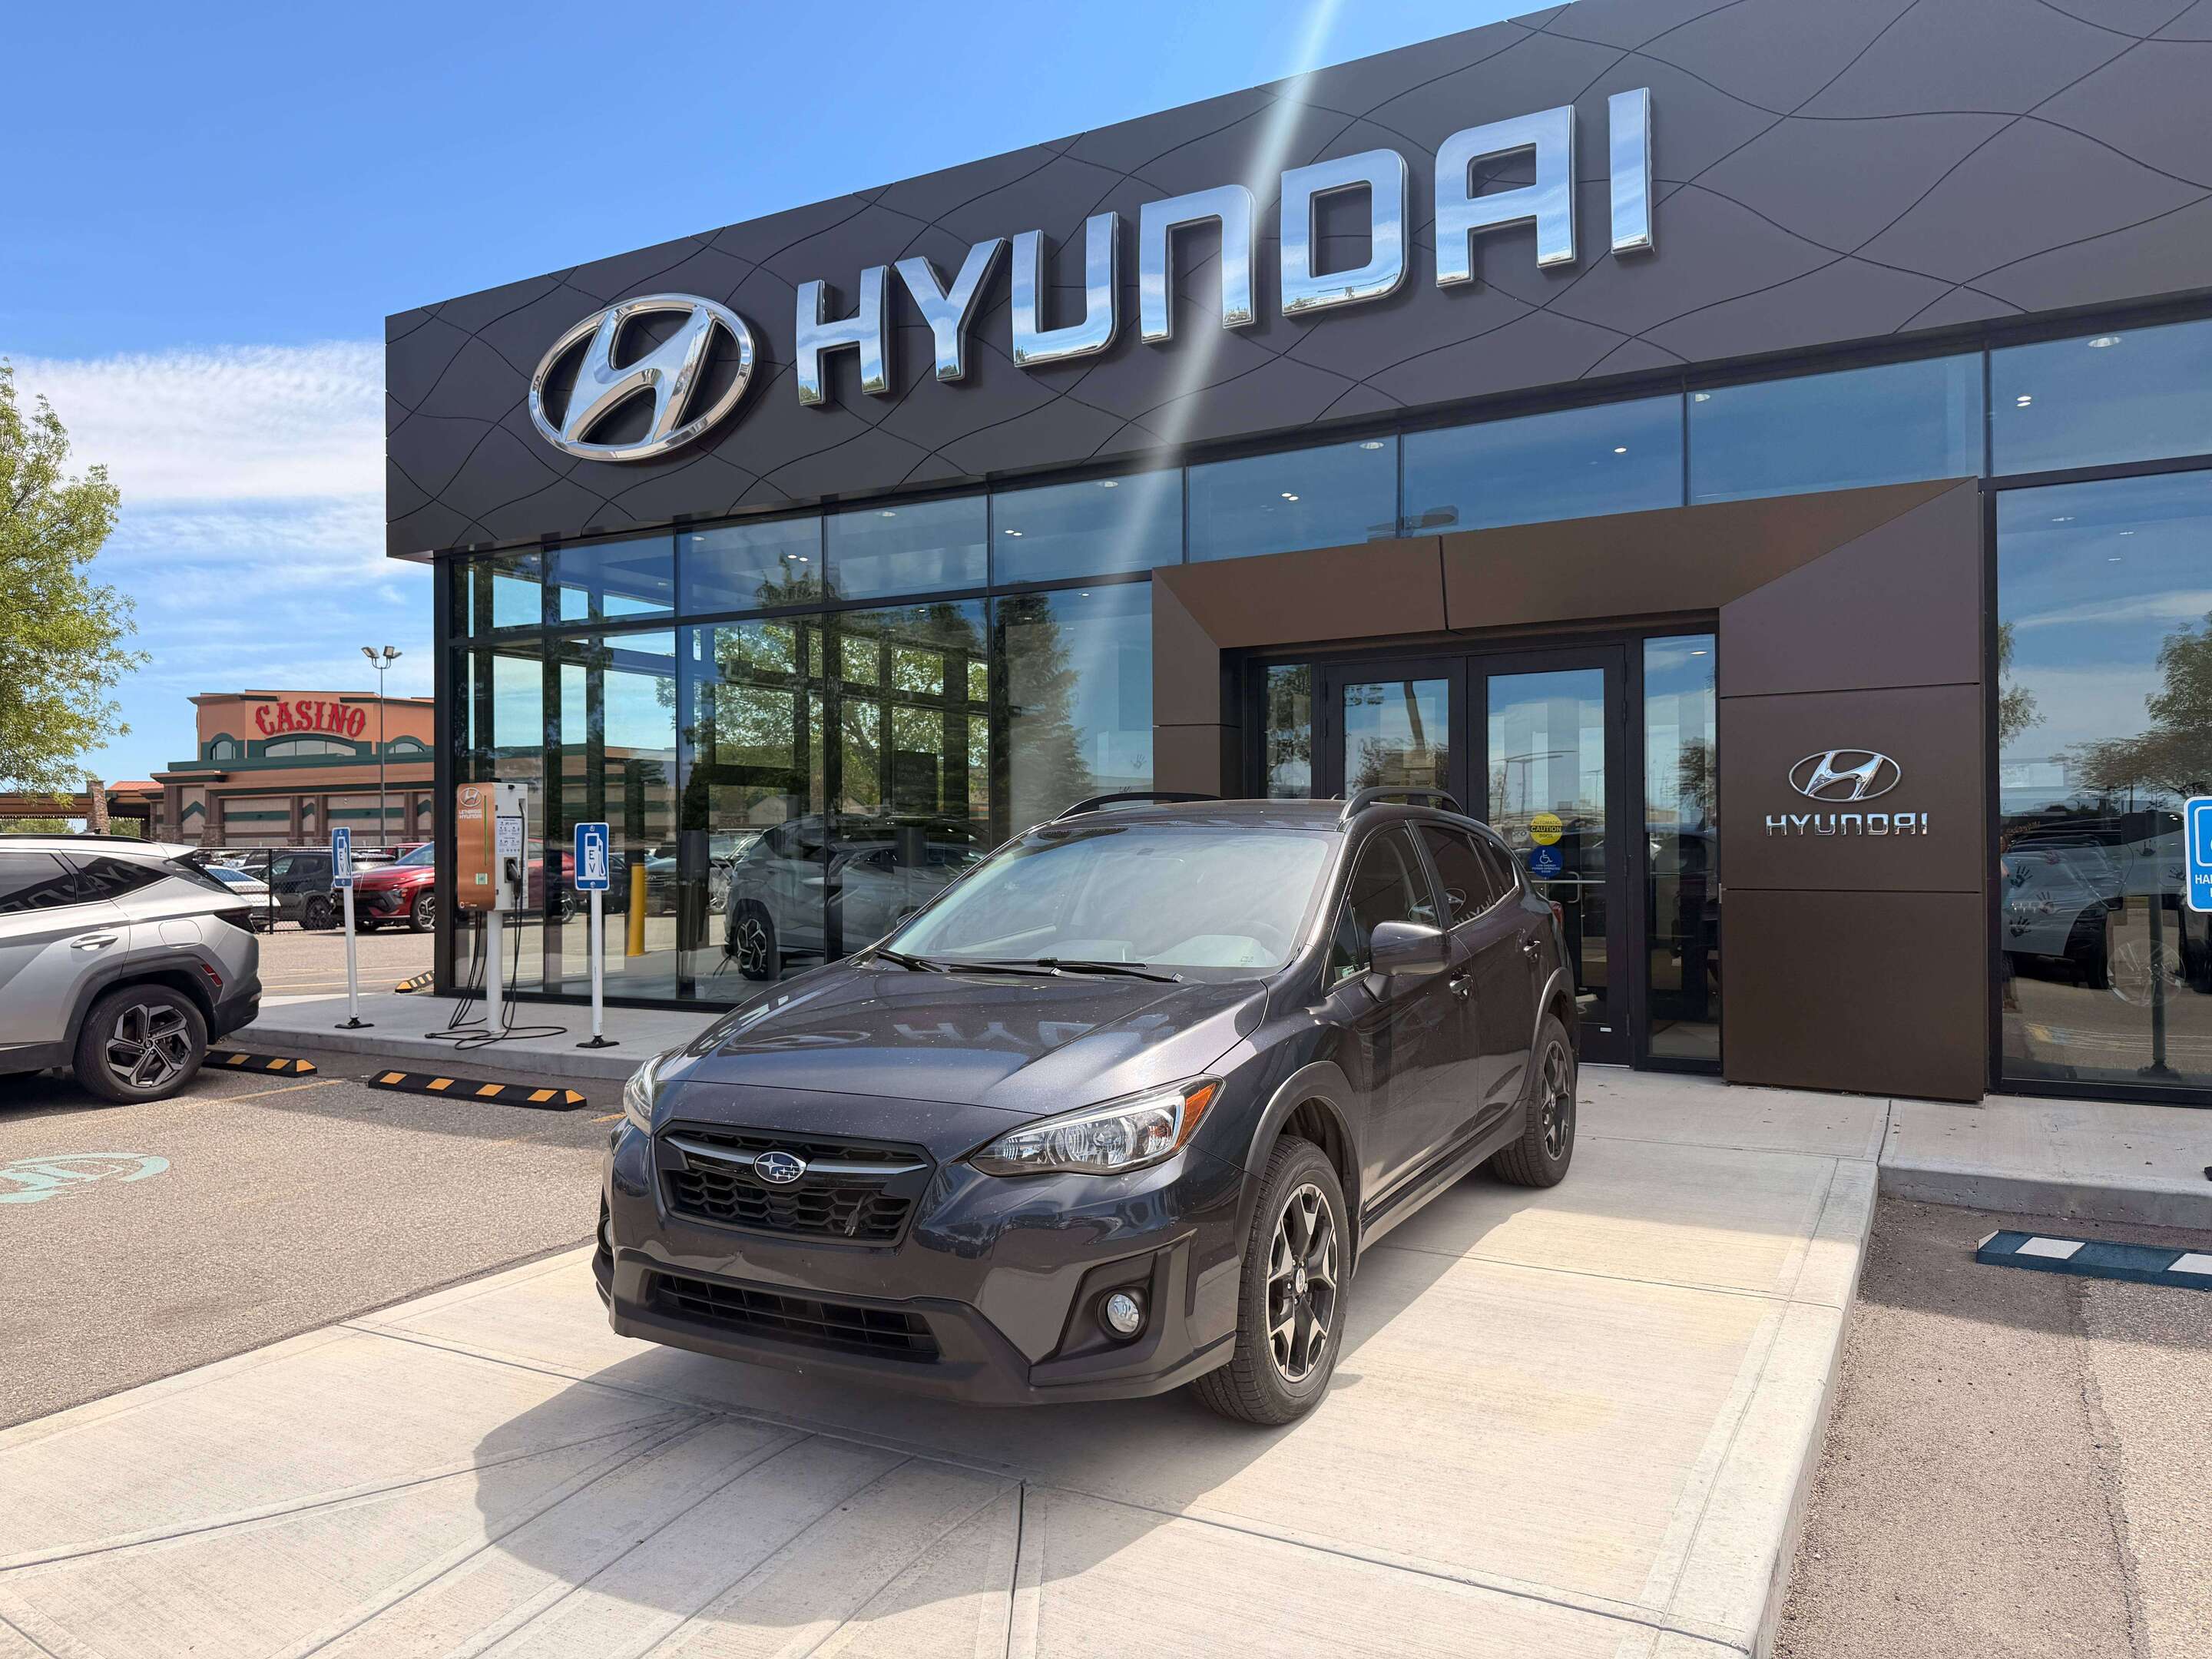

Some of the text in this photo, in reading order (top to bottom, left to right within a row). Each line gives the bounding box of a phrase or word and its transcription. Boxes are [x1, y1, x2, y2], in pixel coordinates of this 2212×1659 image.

[796, 87, 1654, 406] HYUNDAI
[255, 700, 366, 737] CASINO
[1766, 812, 1929, 836] HYUNDAI
[588, 849, 596, 873] EV
